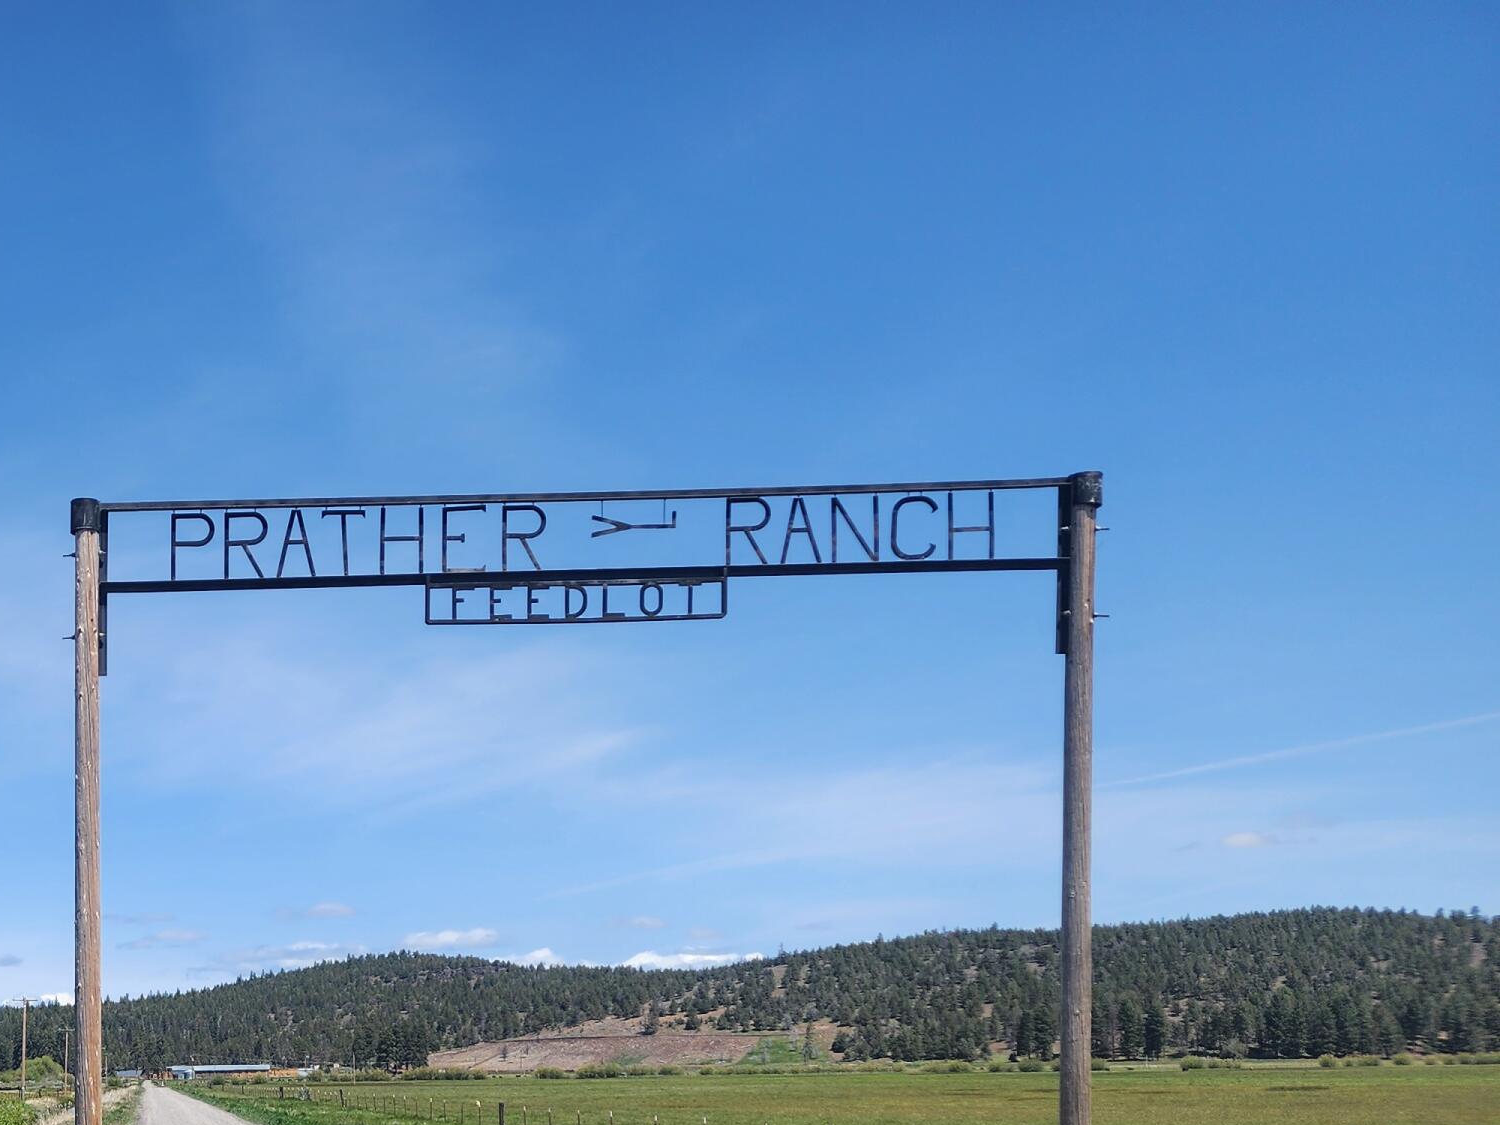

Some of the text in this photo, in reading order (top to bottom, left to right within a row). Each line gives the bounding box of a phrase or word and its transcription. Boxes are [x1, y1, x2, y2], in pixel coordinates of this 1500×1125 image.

[171, 491, 995, 580] PRATHER RANCH
[451, 581, 703, 621] FEEDLOT
